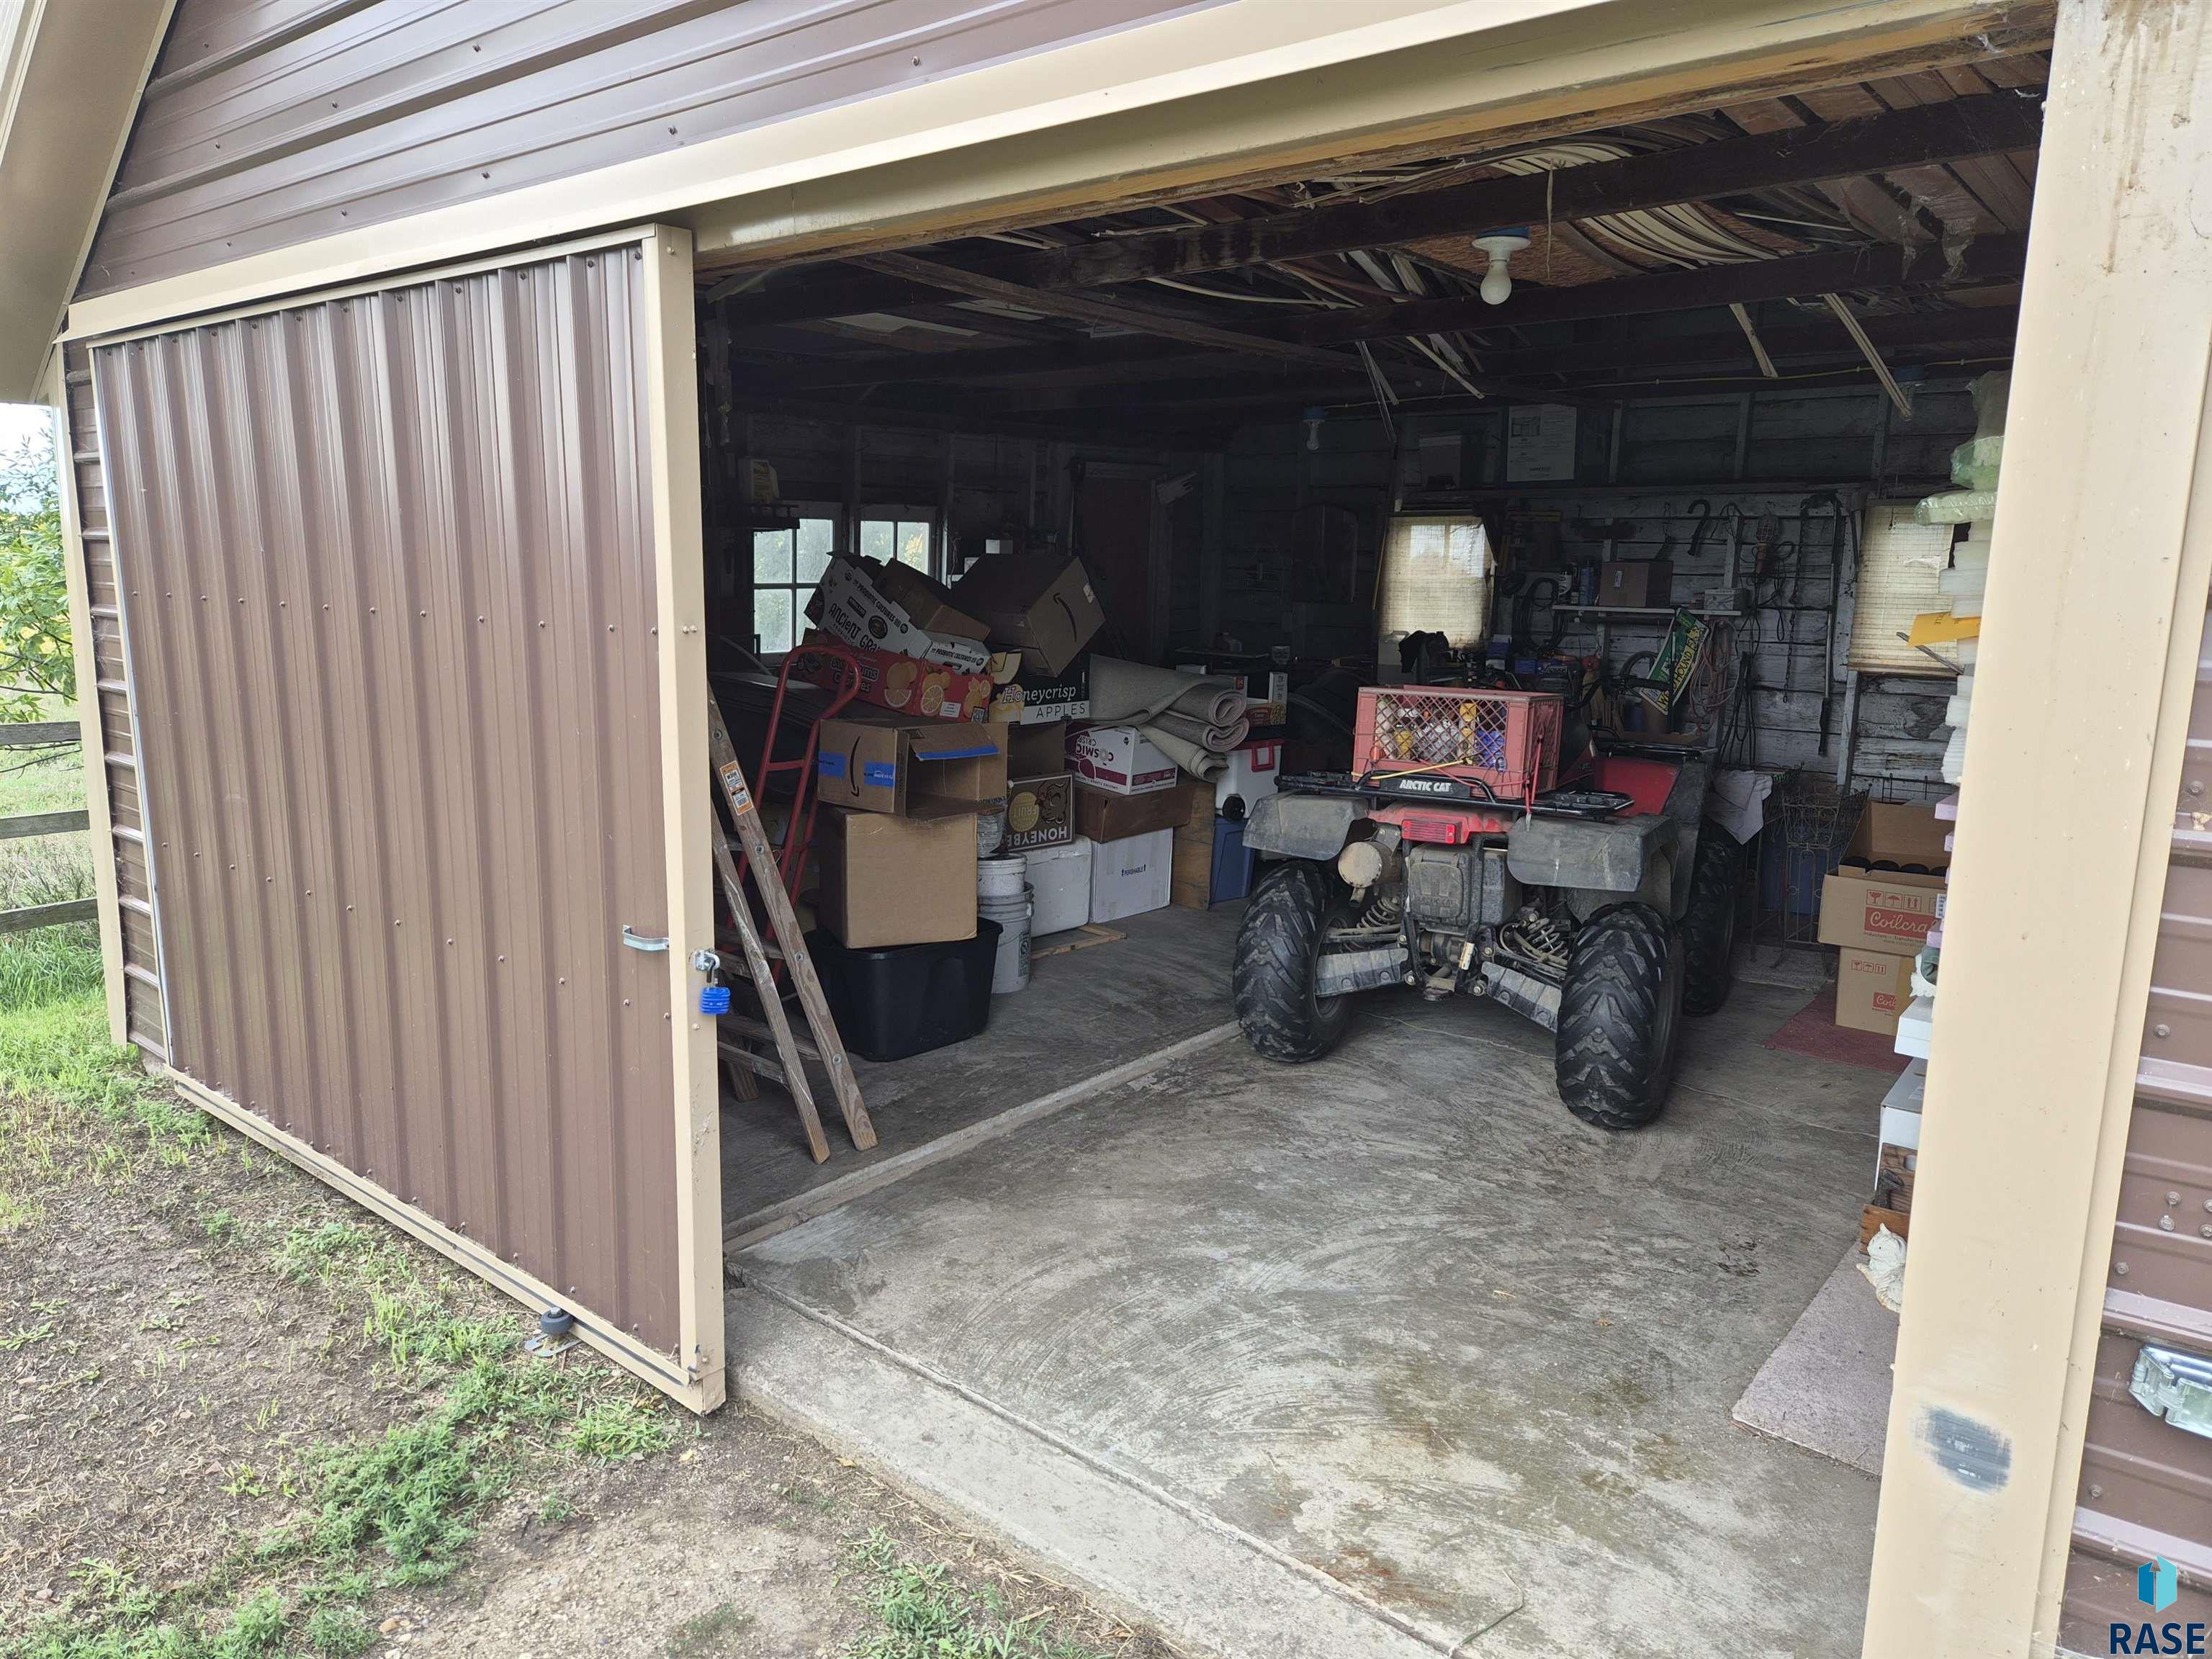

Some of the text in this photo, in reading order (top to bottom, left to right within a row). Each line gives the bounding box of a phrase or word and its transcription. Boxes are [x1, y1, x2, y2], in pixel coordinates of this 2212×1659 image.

[1674, 649, 1693, 683] HOUND
[1002, 683, 1076, 704] Honeycrisp
[1036, 703, 1085, 719] APPLES
[1400, 779, 1452, 792] ARCTIC CAT
[1012, 806, 1037, 818] FRUIT
[1007, 826, 1067, 847] HONEYBE
